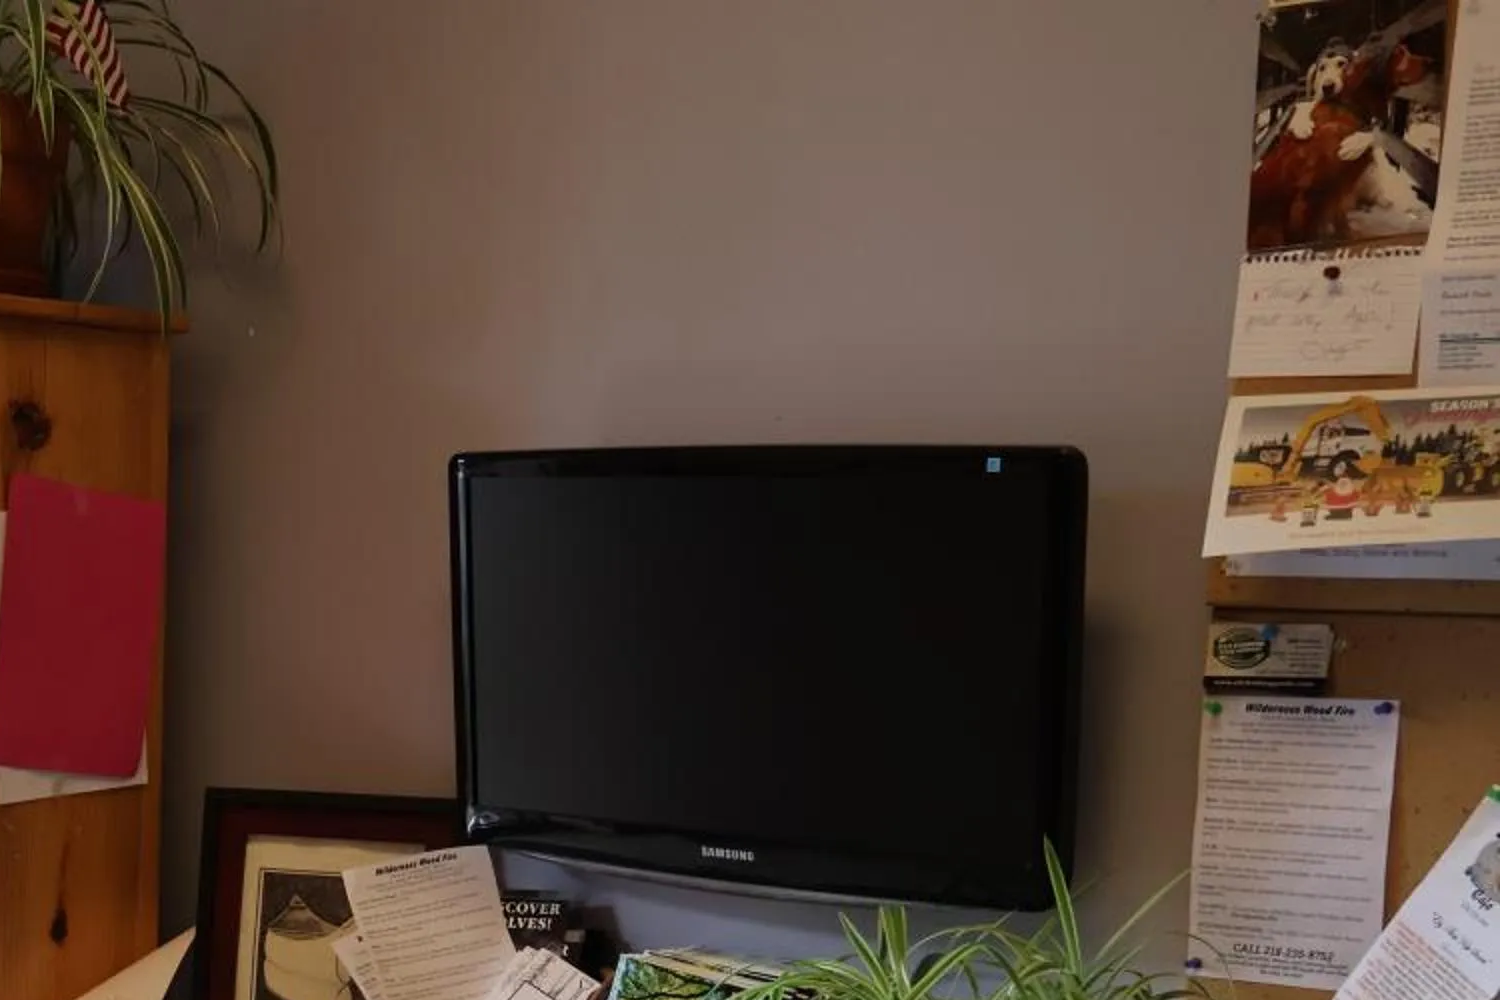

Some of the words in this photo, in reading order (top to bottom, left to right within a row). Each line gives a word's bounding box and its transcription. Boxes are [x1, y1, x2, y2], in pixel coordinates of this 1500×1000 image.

[1246, 703, 1301, 715] Wilderness
[1303, 704, 1332, 715] Wood
[1335, 705, 1355, 717] Fire
[701, 845, 755, 862] SAMSUNG
[1233, 944, 1262, 955] CALL
